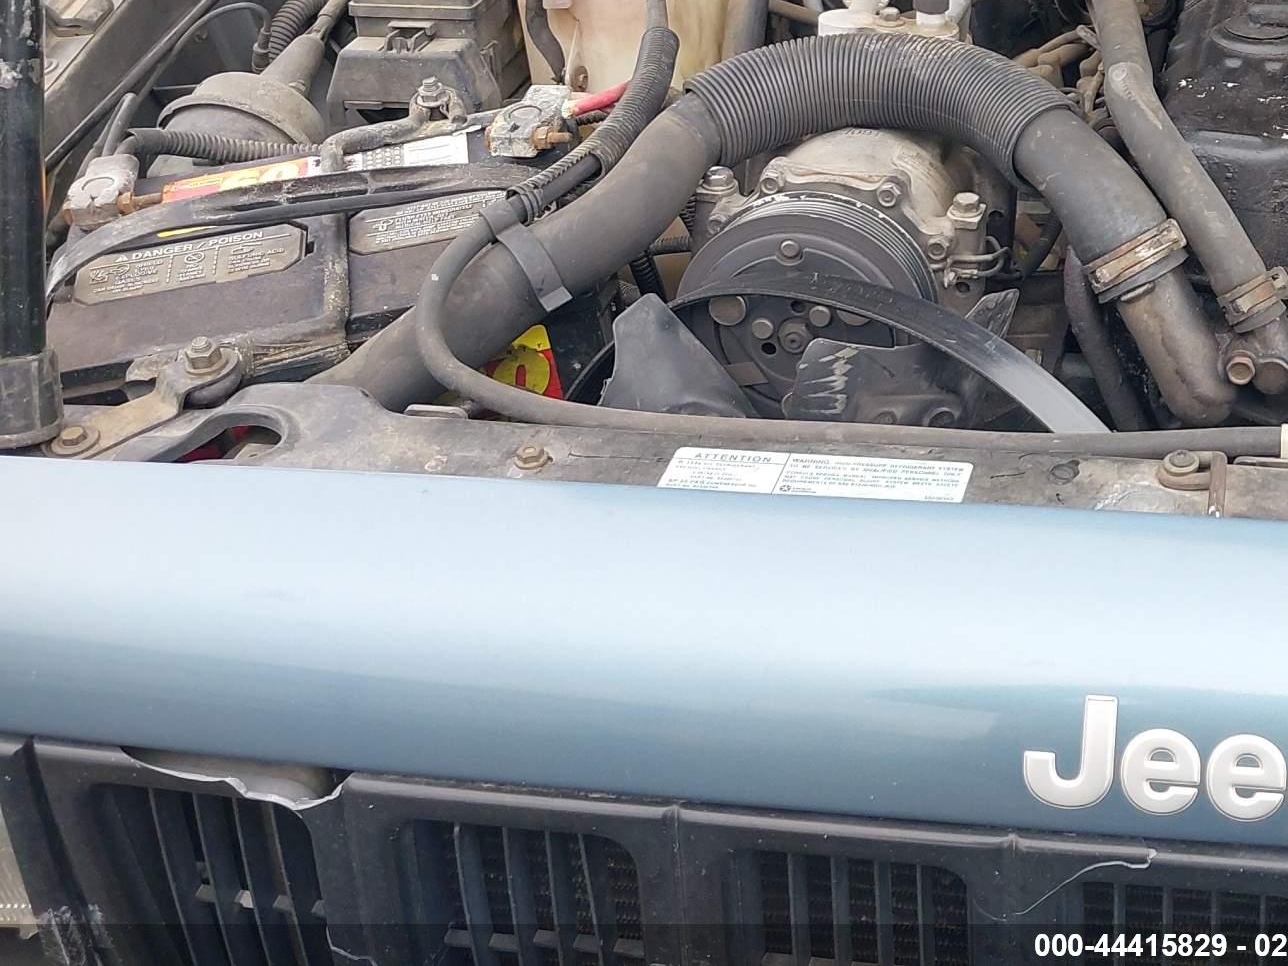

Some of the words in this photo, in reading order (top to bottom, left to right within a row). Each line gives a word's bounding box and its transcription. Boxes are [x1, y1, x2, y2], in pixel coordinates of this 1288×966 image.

[131, 244, 193, 260] DANGER
[208, 231, 263, 247] POISON
[694, 452, 772, 463] ATTENTION
